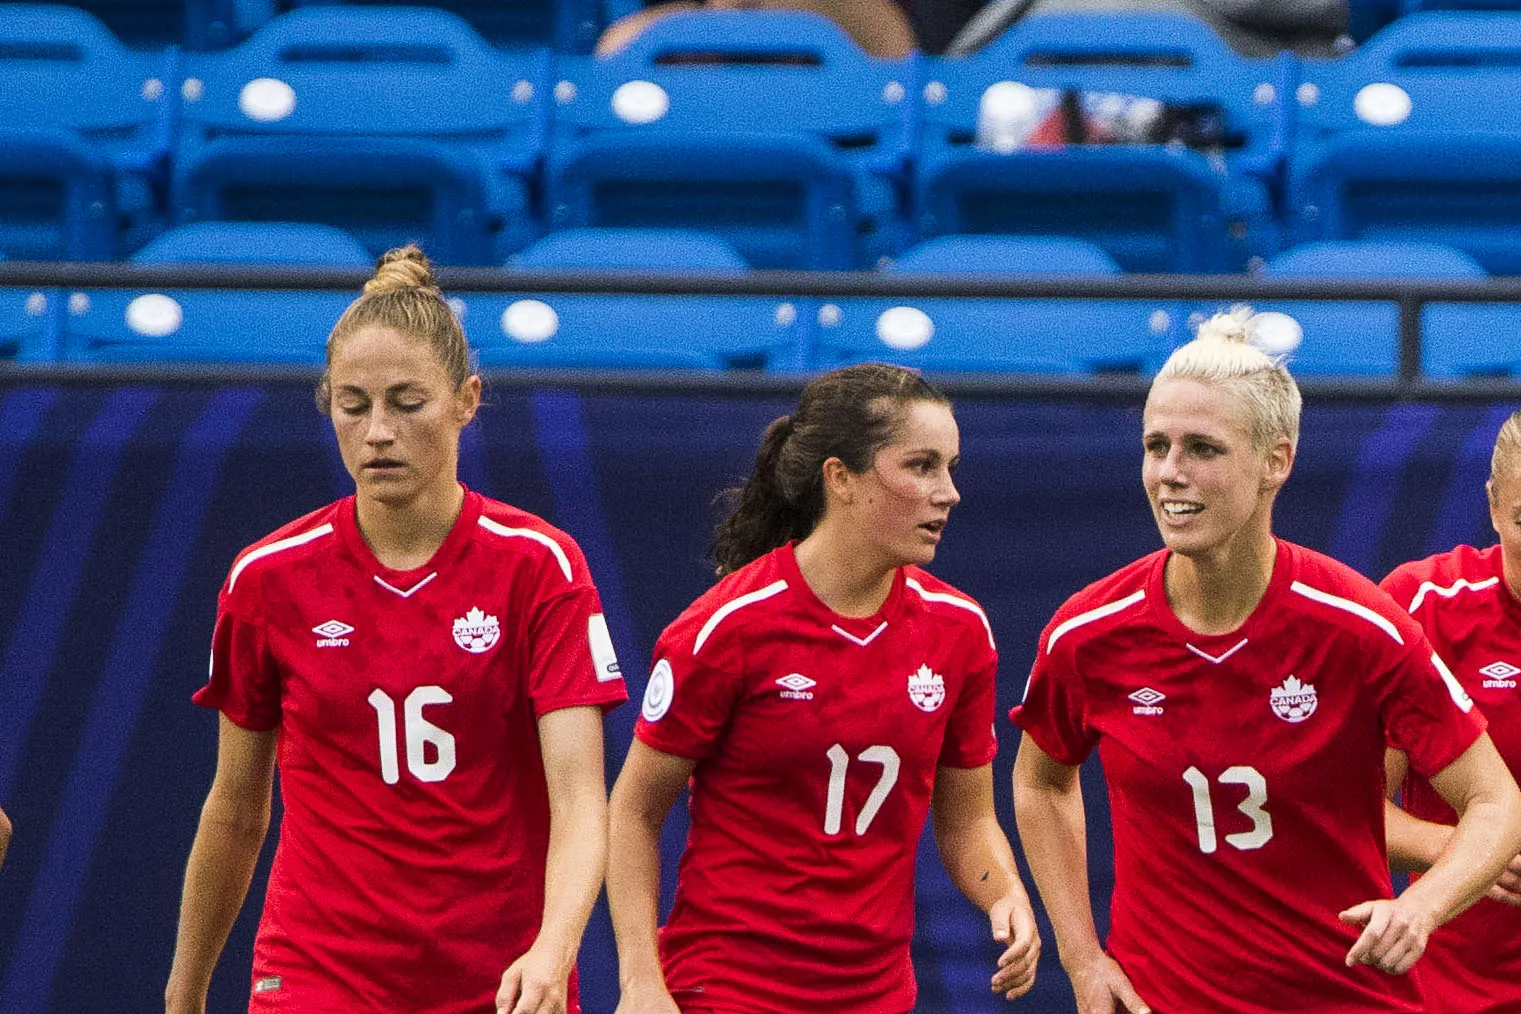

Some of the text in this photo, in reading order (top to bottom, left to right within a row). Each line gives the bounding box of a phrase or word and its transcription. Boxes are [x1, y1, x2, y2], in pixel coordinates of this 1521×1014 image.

[316, 638, 350, 648] umbro
[1482, 679, 1517, 689] umbro
[779, 690, 814, 700] umbro
[1269, 693, 1317, 707] CANADA
[368, 685, 456, 785] 16
[824, 743, 901, 836] 17
[1182, 766, 1273, 854] 13
